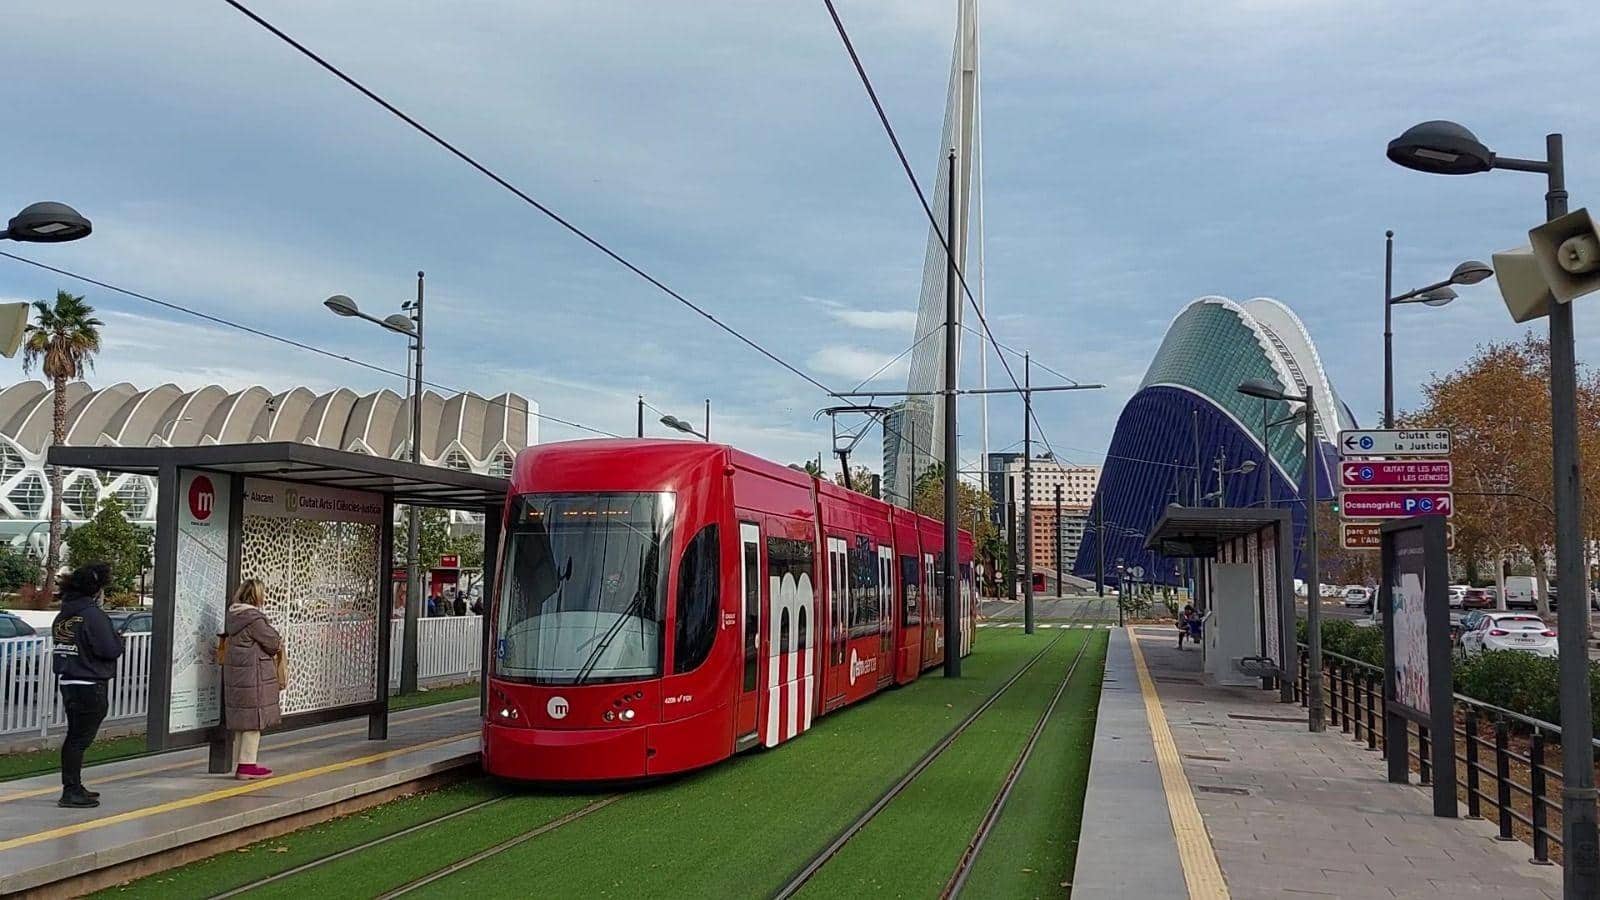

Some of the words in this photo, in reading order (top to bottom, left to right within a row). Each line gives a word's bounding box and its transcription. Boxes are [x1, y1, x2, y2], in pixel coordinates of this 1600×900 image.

[1394, 442, 1404, 450] la
[1383, 465, 1405, 473] CIUTAT
[1407, 465, 1416, 473] DE
[1417, 465, 1430, 473] LES
[1431, 465, 1449, 473] ARTS
[1406, 499, 1415, 510] P
[1346, 528, 1365, 537] parc
[1346, 536, 1357, 544] de
